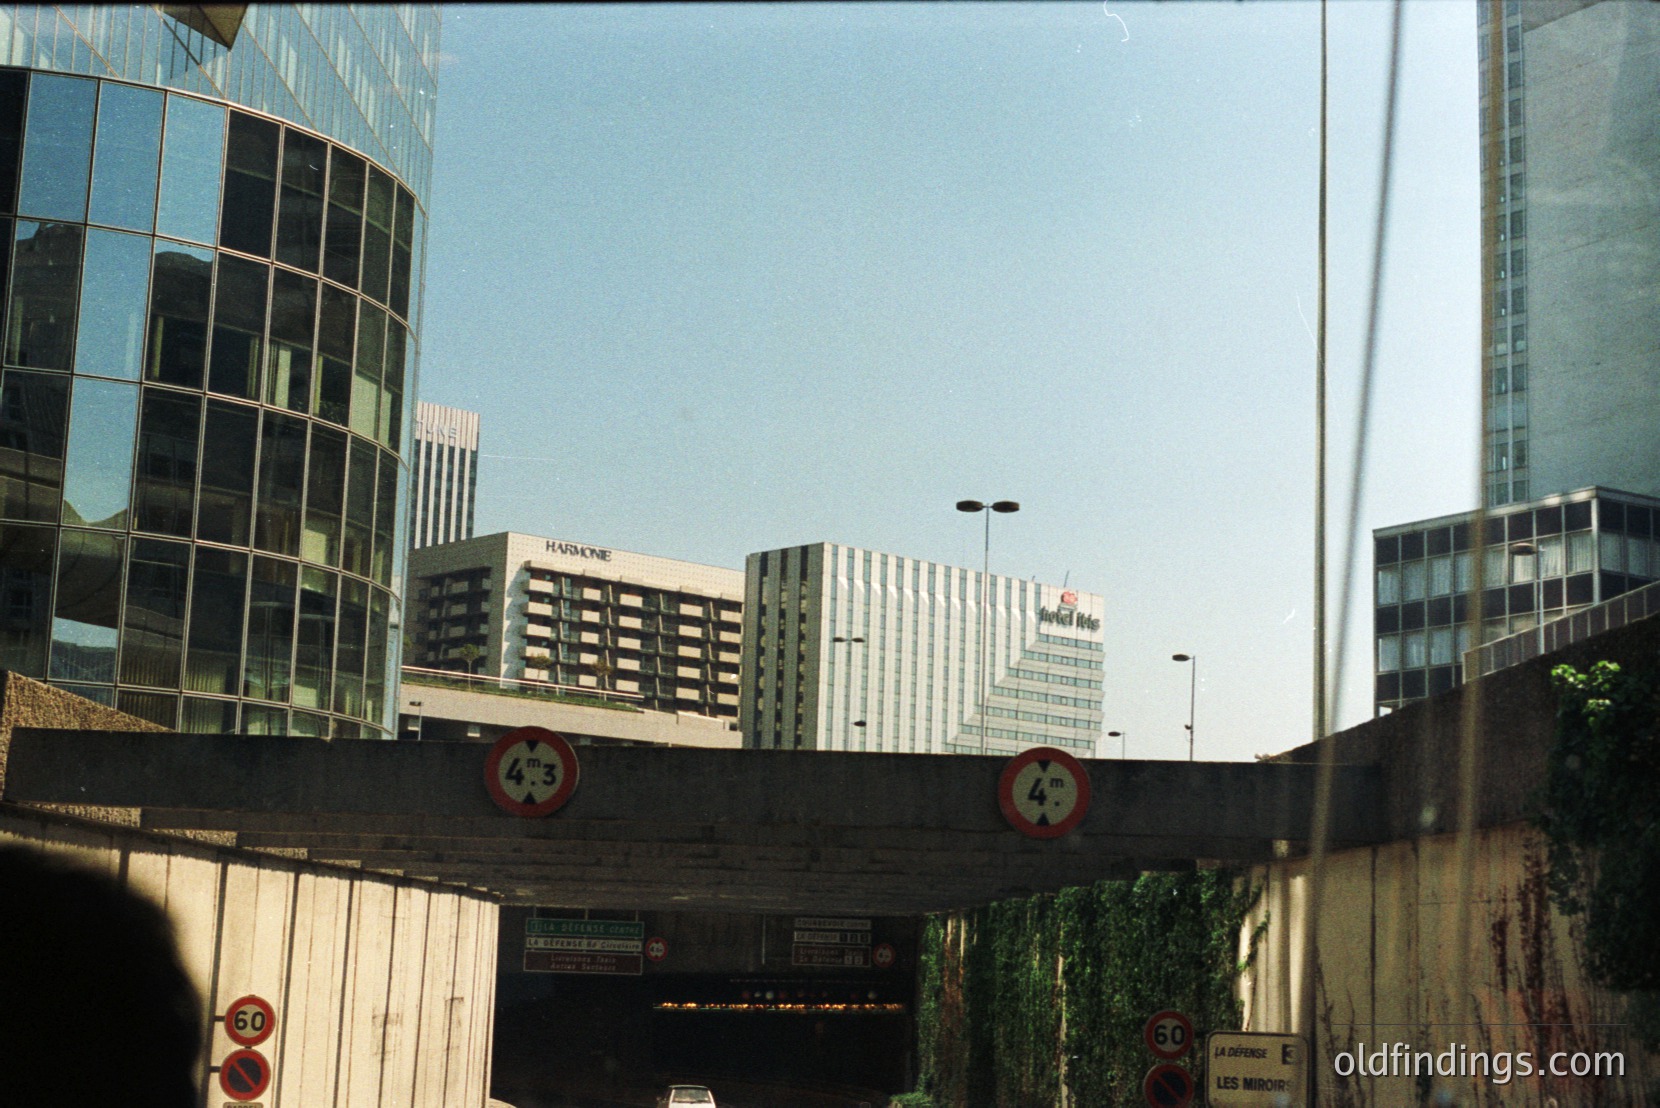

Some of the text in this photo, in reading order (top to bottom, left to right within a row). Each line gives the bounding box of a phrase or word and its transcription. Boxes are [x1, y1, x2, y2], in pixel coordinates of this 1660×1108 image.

[545, 540, 612, 562] HARMONIE
[528, 938, 539, 946] LA
[234, 1010, 266, 1031] 60
[1154, 1025, 1185, 1045] 60
[1215, 1046, 1226, 1058] LA
[1227, 1045, 1268, 1059] DÉFENSE
[1217, 1076, 1239, 1090] LES
